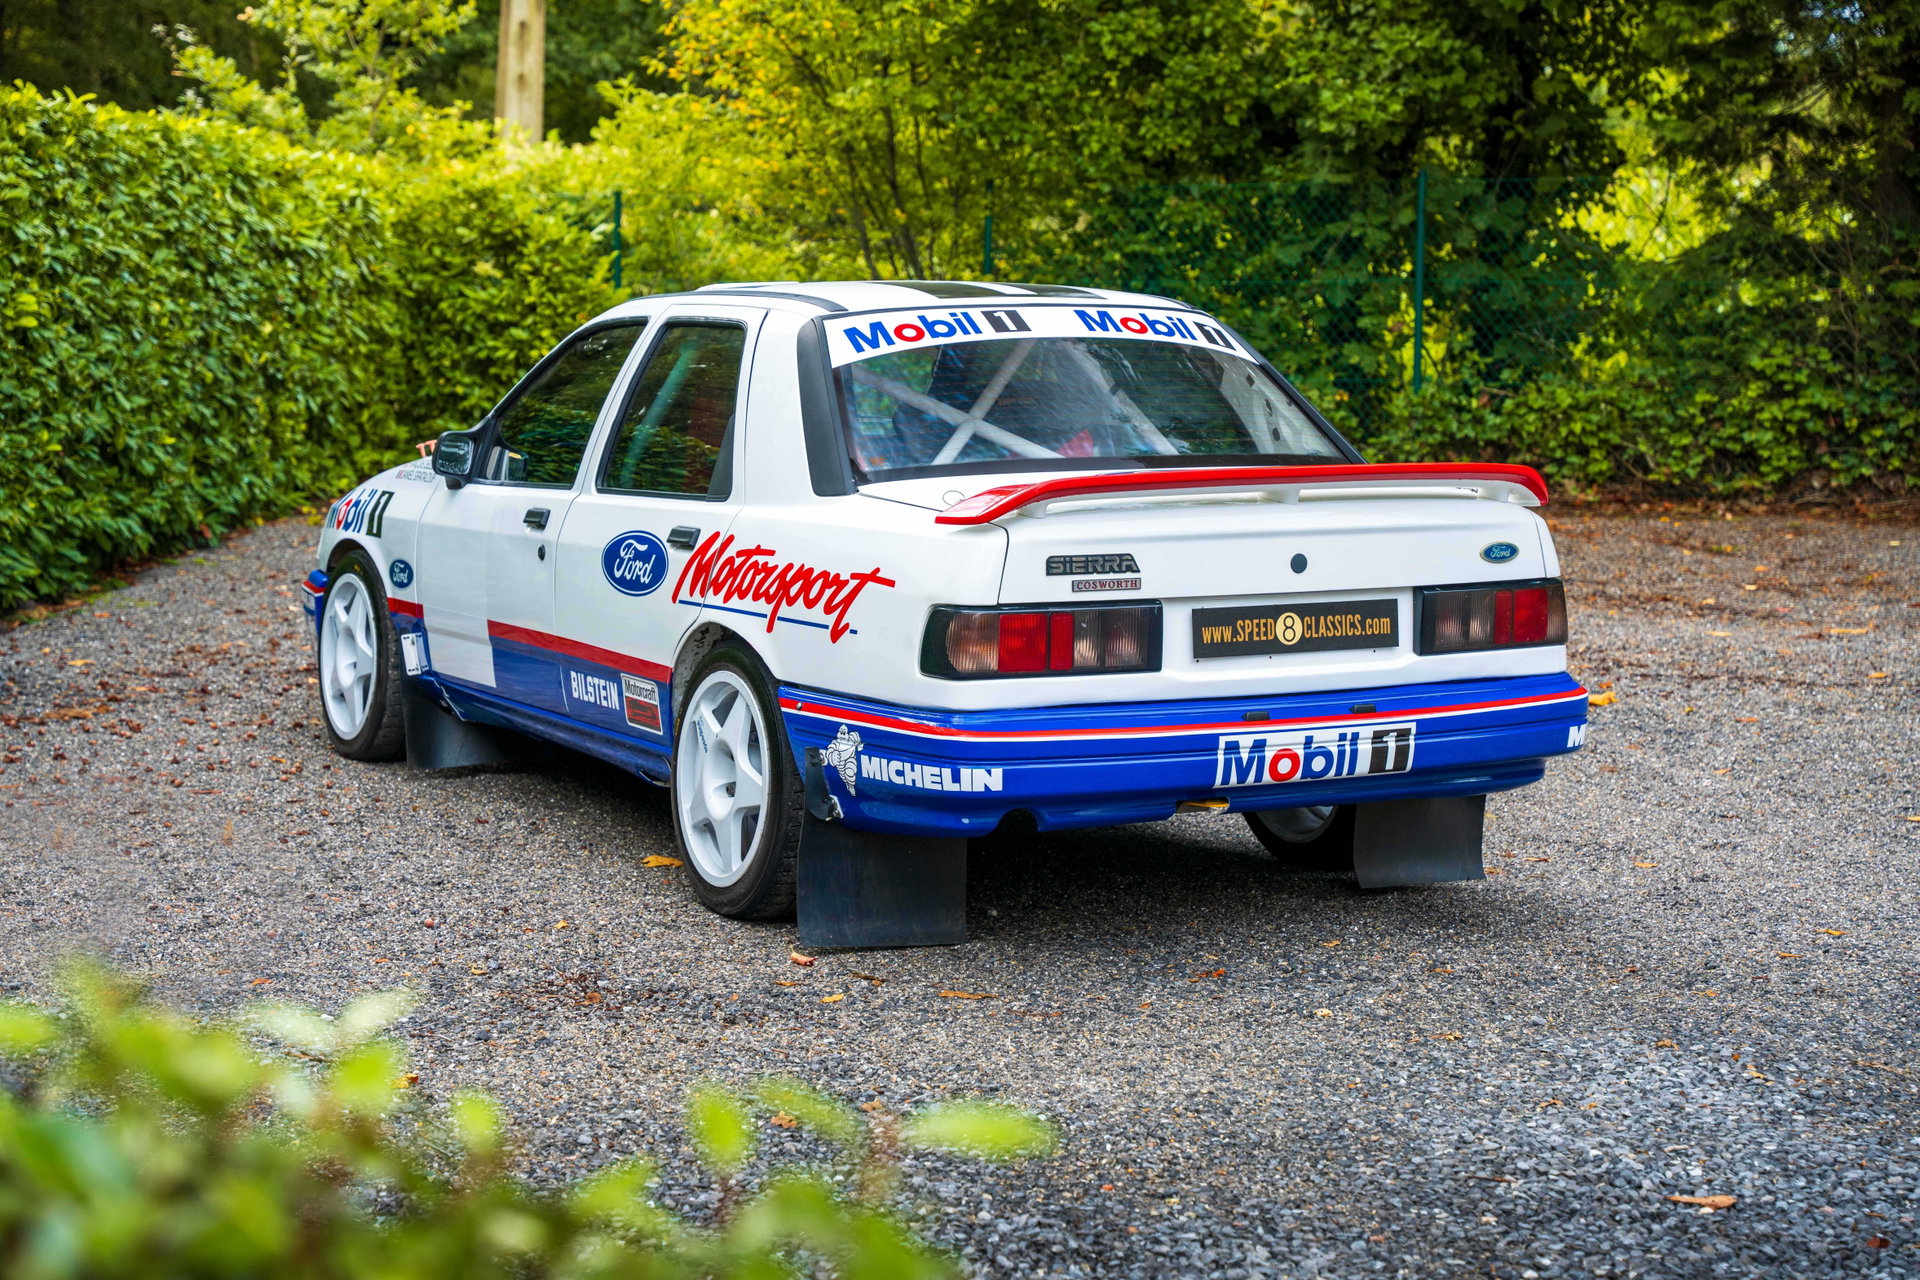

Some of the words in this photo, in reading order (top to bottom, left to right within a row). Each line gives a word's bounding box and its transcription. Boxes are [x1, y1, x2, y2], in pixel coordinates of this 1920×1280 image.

[843, 311, 983, 353] Mobil
[991, 310, 1020, 332] 1
[1073, 310, 1198, 341] Mobil
[326, 487, 378, 533] Mobil
[1489, 545, 1511, 558] Ford
[392, 562, 409, 584] Ford
[614, 539, 657, 585] Ford
[671, 530, 896, 644] Motorsport
[1076, 579, 1138, 590] COSWORTH
[1202, 613, 1391, 645] www.SPEED8CLASSICS.com
[570, 670, 620, 711] BILSTEIN
[624, 679, 657, 702] Motorcraft
[860, 754, 1003, 792] MICHELIN
[1220, 731, 1360, 786] Mobil
